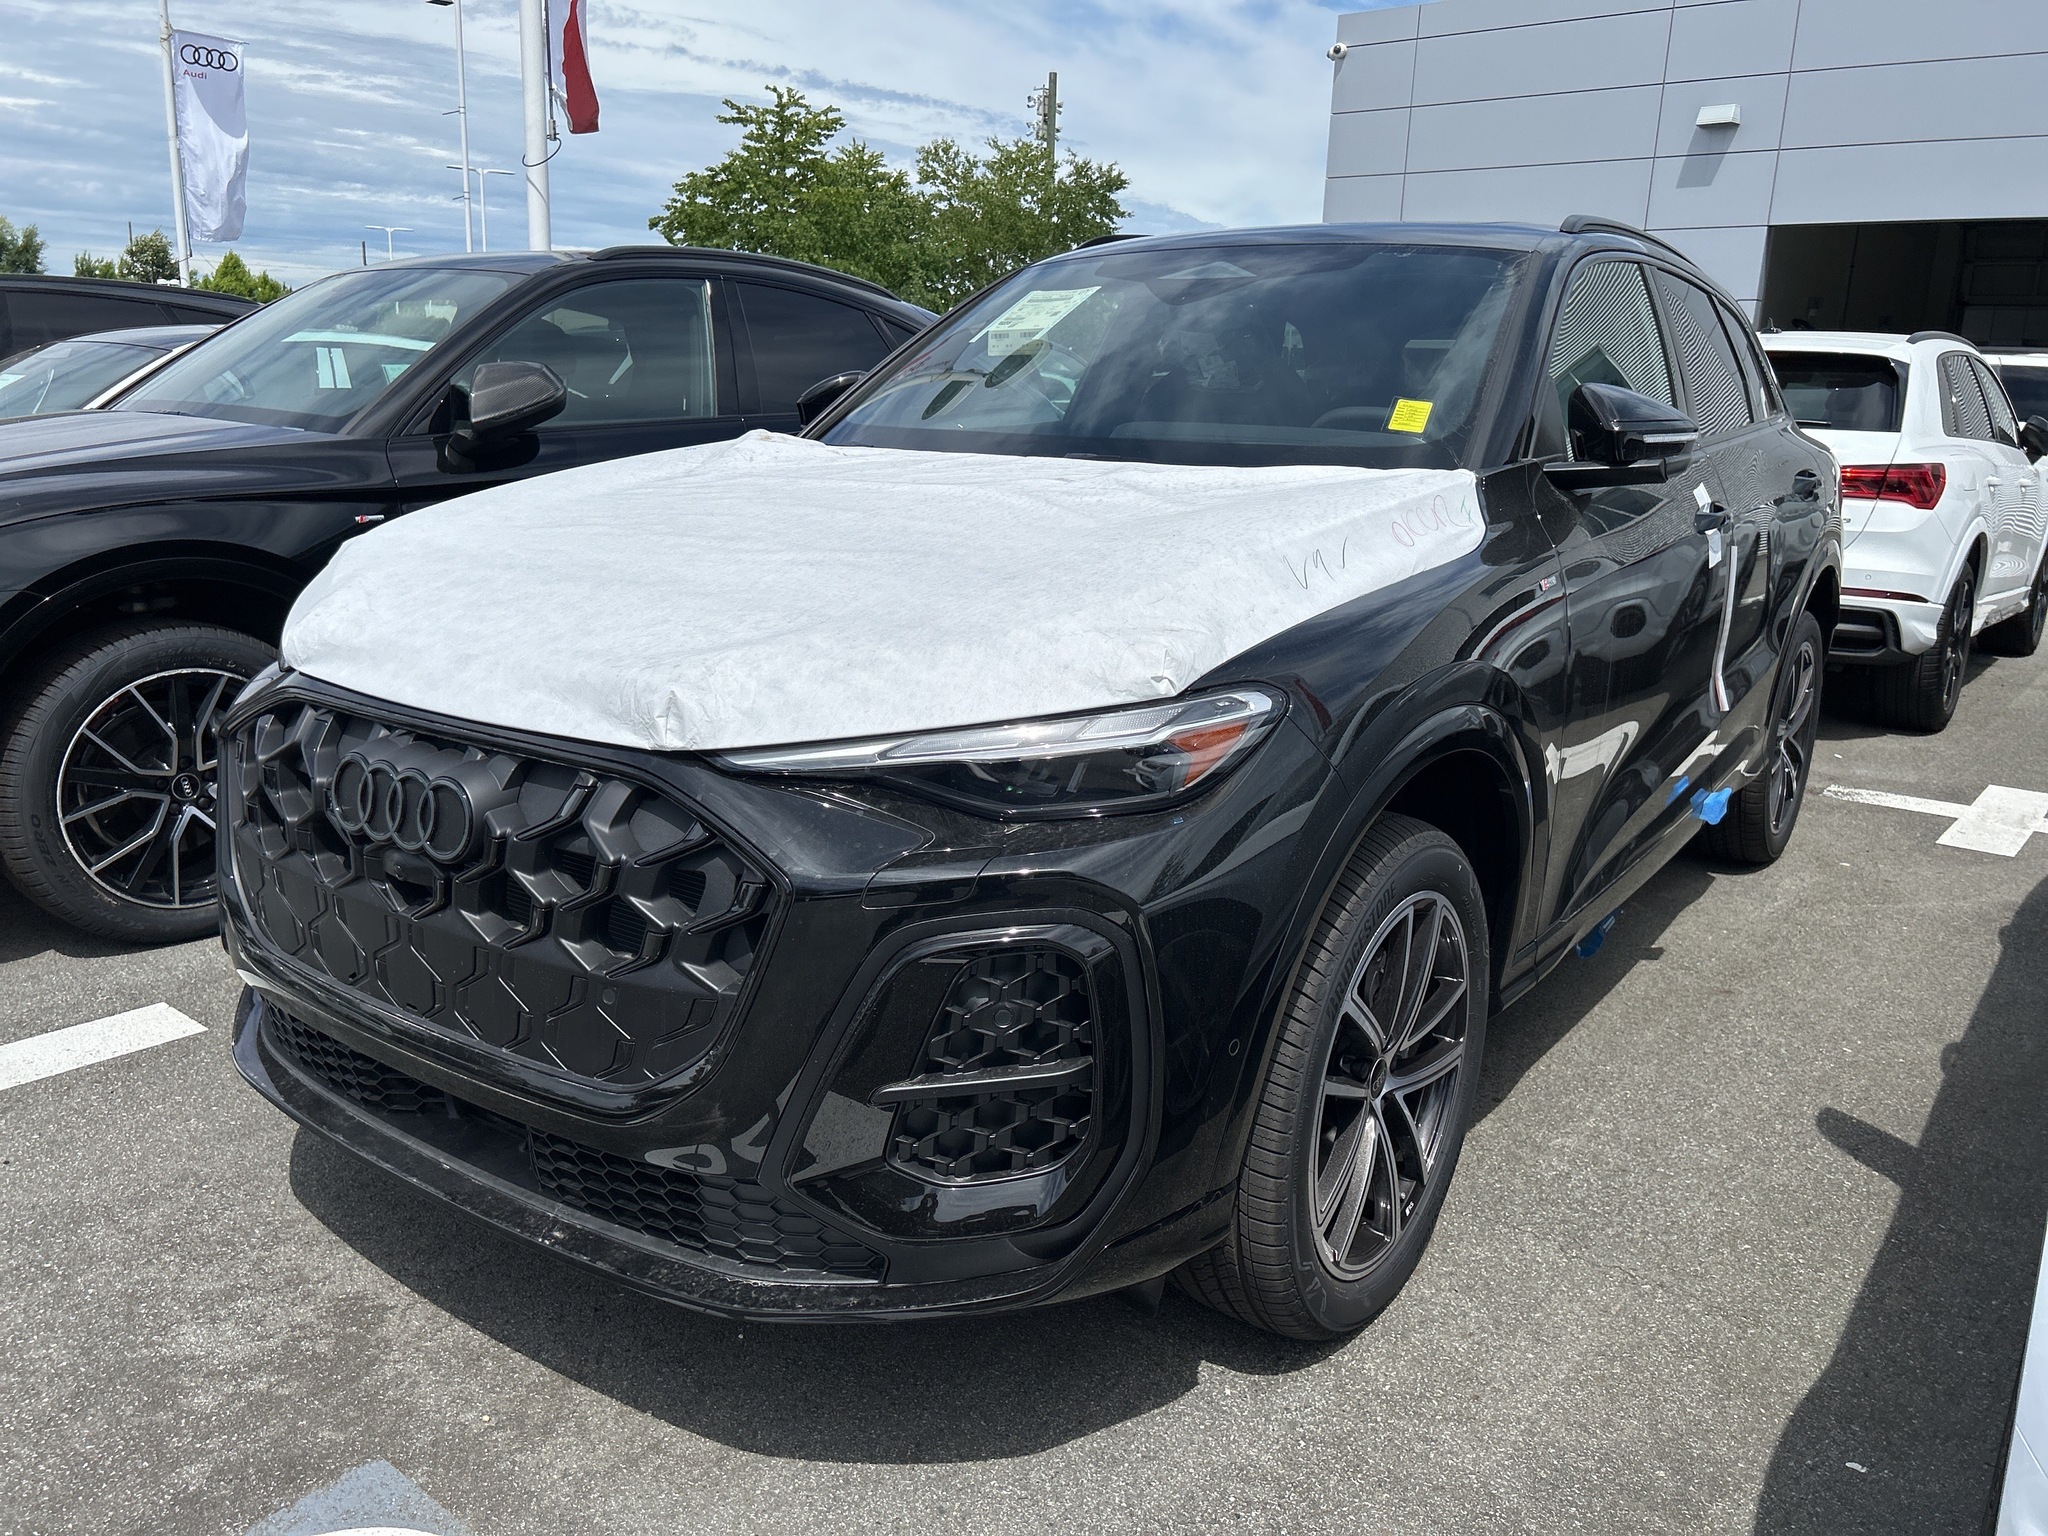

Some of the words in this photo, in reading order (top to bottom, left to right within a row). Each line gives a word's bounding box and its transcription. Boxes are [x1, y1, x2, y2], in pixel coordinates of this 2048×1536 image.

[182, 69, 208, 80] Audi
[30, 813, 58, 867] ZERO
[1325, 879, 1398, 1023] BRIDGESTONE
